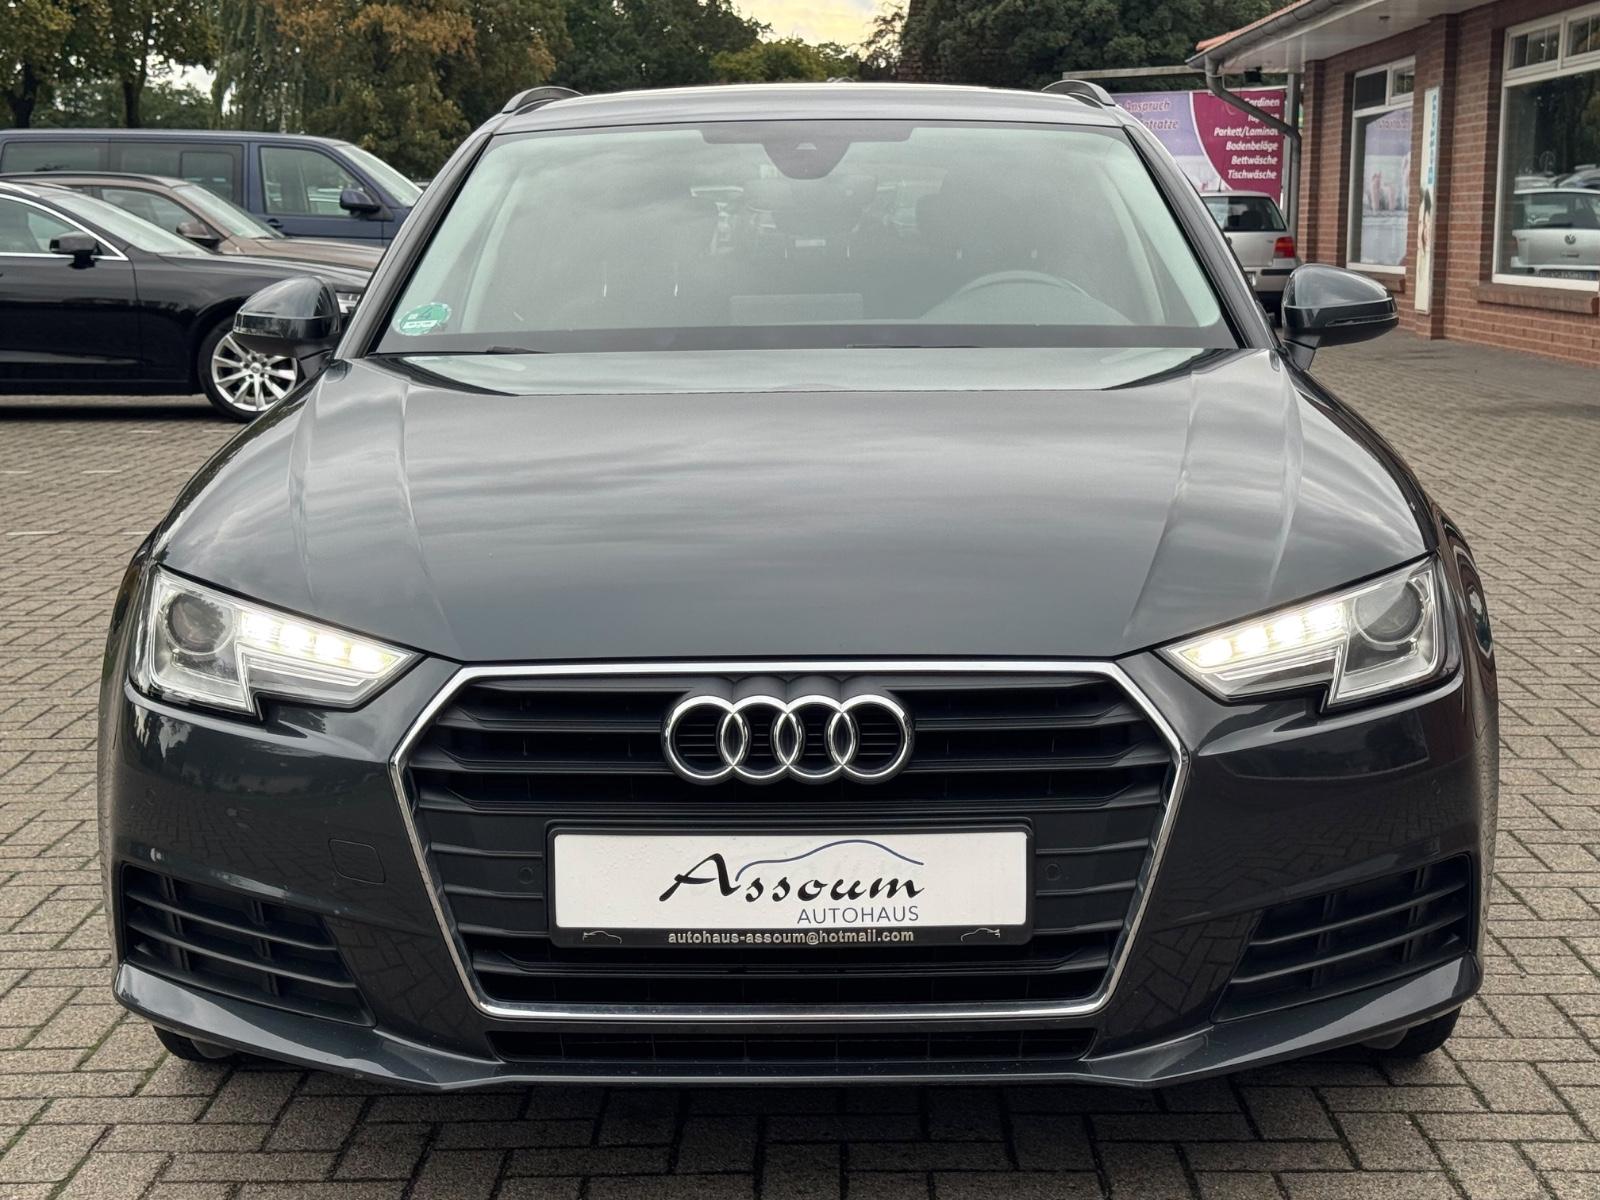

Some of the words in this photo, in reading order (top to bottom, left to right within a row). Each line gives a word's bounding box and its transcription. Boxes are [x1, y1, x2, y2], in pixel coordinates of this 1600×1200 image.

[1141, 119, 1178, 130] atratze
[1226, 140, 1279, 152] Bodenbeläge
[1231, 155, 1279, 165] Bettwäsche
[1228, 169, 1278, 179] Tischwäsche
[659, 853, 925, 902] Assoum
[797, 905, 919, 924] AUTOHAUS
[667, 929, 915, 945] autohaus-assoum@hotmail.com
